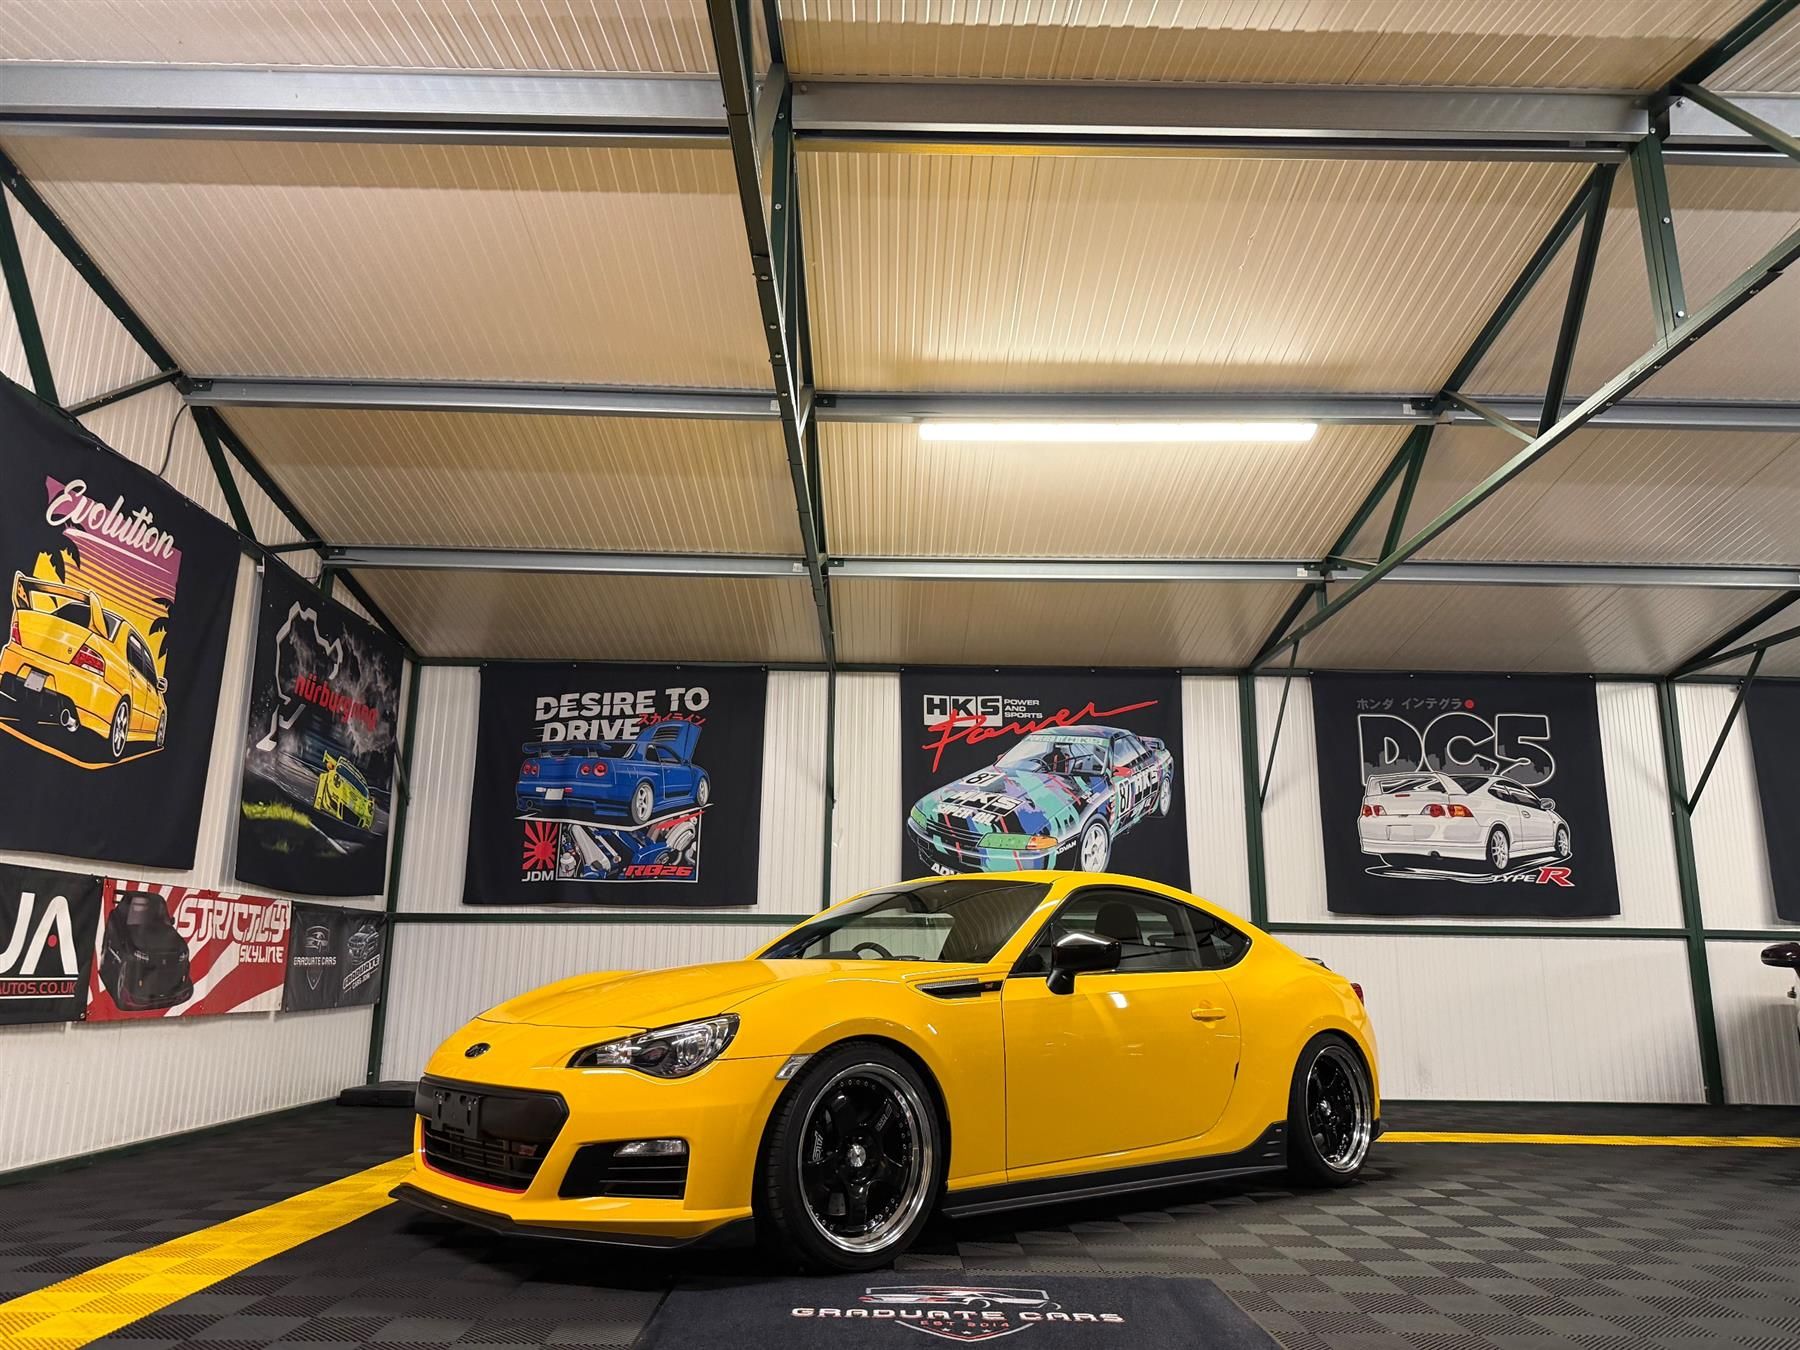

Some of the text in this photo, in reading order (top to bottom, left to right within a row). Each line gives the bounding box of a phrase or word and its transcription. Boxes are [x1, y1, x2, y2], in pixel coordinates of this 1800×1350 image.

[46, 479, 174, 559] Evolution
[535, 687, 710, 721] DESIRE TO
[925, 695, 1001, 718] HKS
[1004, 698, 1040, 706] POWER
[1356, 698, 1463, 710] ホンダ インテグラ
[1004, 711, 1043, 719] SPORTS
[541, 718, 641, 742] DRIVE
[922, 700, 1159, 774] Power
[1358, 712, 1556, 788] DC5
[946, 790, 1021, 813] HKS
[521, 870, 554, 882] JDM
[1490, 866, 1576, 887] TYPE R
[176, 897, 286, 944] STRICTLY
[239, 944, 285, 964] SKYLINE
[321, 956, 337, 966] CARS
[790, 1307, 1126, 1324] GRADUATE CARS
